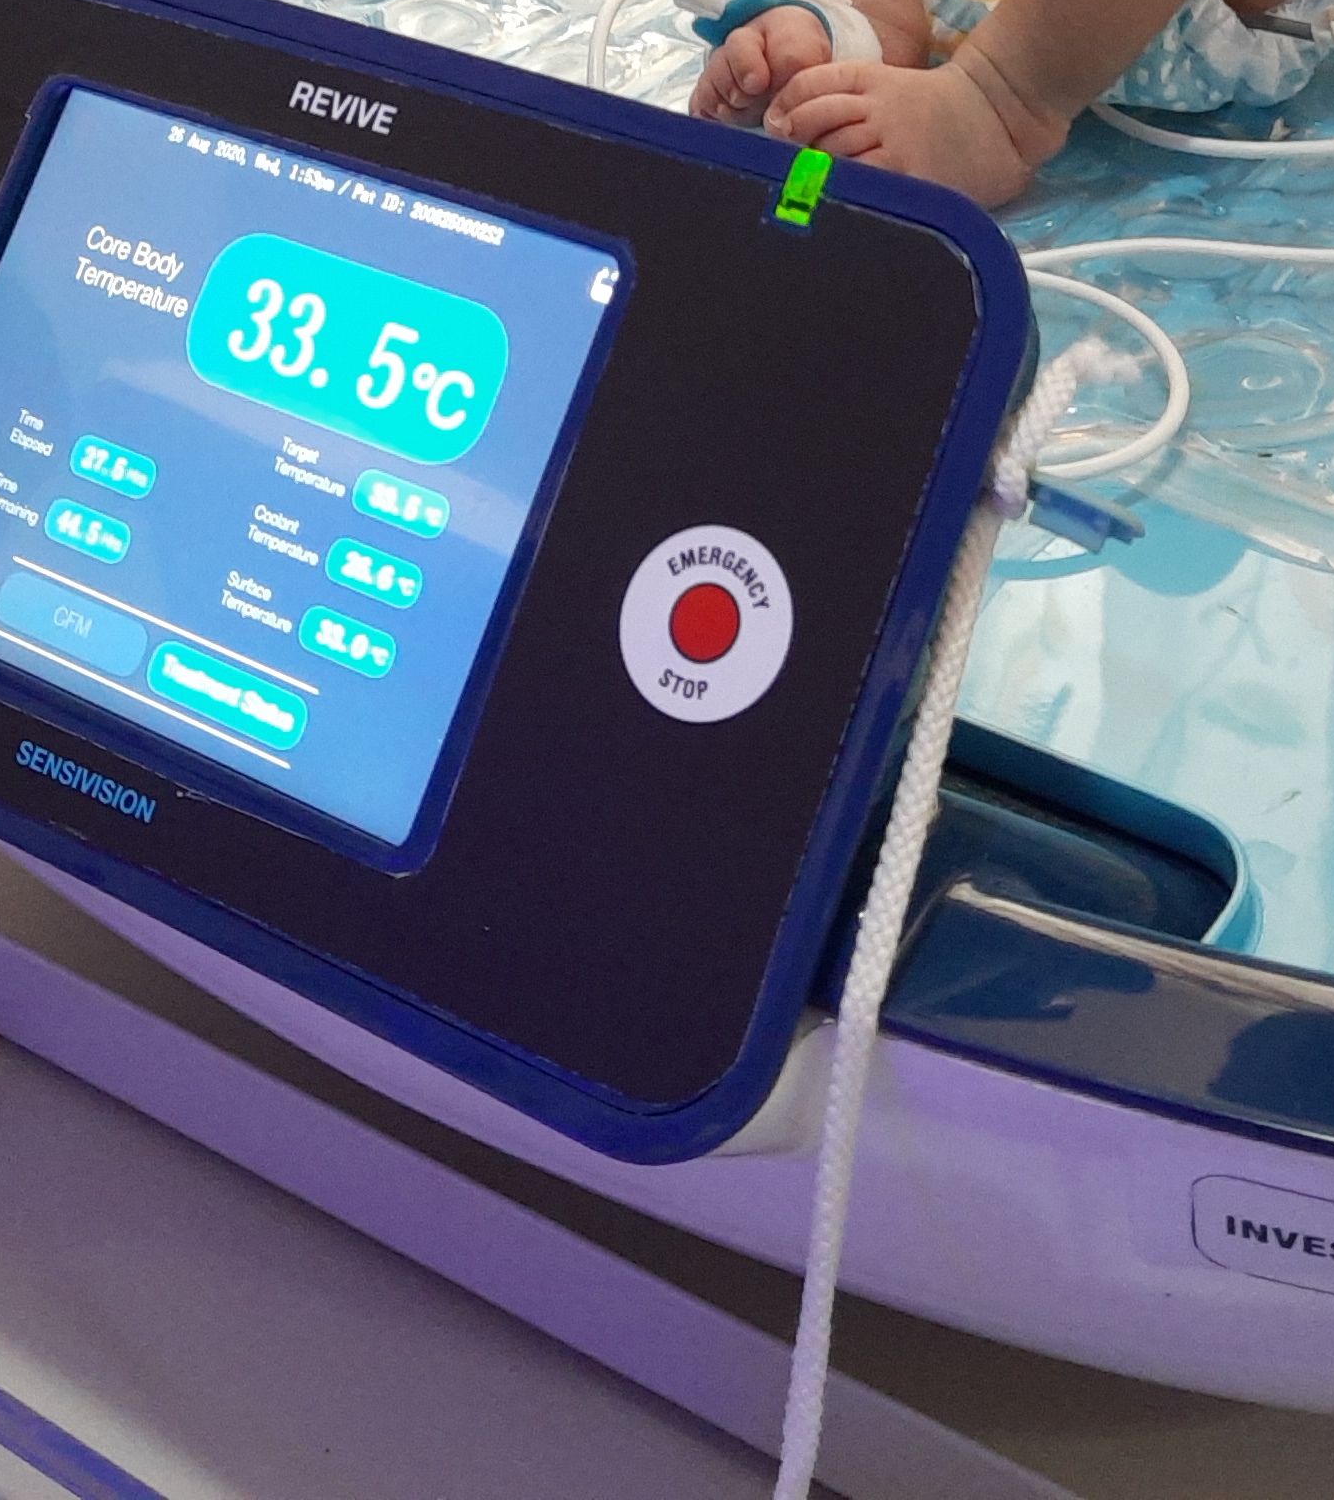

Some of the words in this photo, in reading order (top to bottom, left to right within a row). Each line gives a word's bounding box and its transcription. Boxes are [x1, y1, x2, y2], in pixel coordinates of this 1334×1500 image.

[288, 79, 399, 136] REVIVE
[186, 131, 212, 154] Aug
[214, 138, 248, 166] 2020,
[351, 182, 378, 206] Pat
[380, 190, 407, 215] ID:
[84, 224, 133, 260] Core
[132, 241, 186, 283] Body
[73, 256, 190, 319] Temperature
[19, 407, 45, 432] Time
[9, 426, 55, 458] Elapsed
[281, 436, 321, 465] Target
[274, 455, 347, 499] Temperature
[254, 504, 301, 536] Coolant
[247, 522, 320, 567] Temperature
[226, 570, 273, 602] Surface
[666, 545, 770, 610] EMERGENCY
[53, 604, 93, 639] CFM
[221, 588, 294, 634] Temperature
[658, 667, 709, 701] STOP
[15, 739, 157, 825] SENSIVISION
